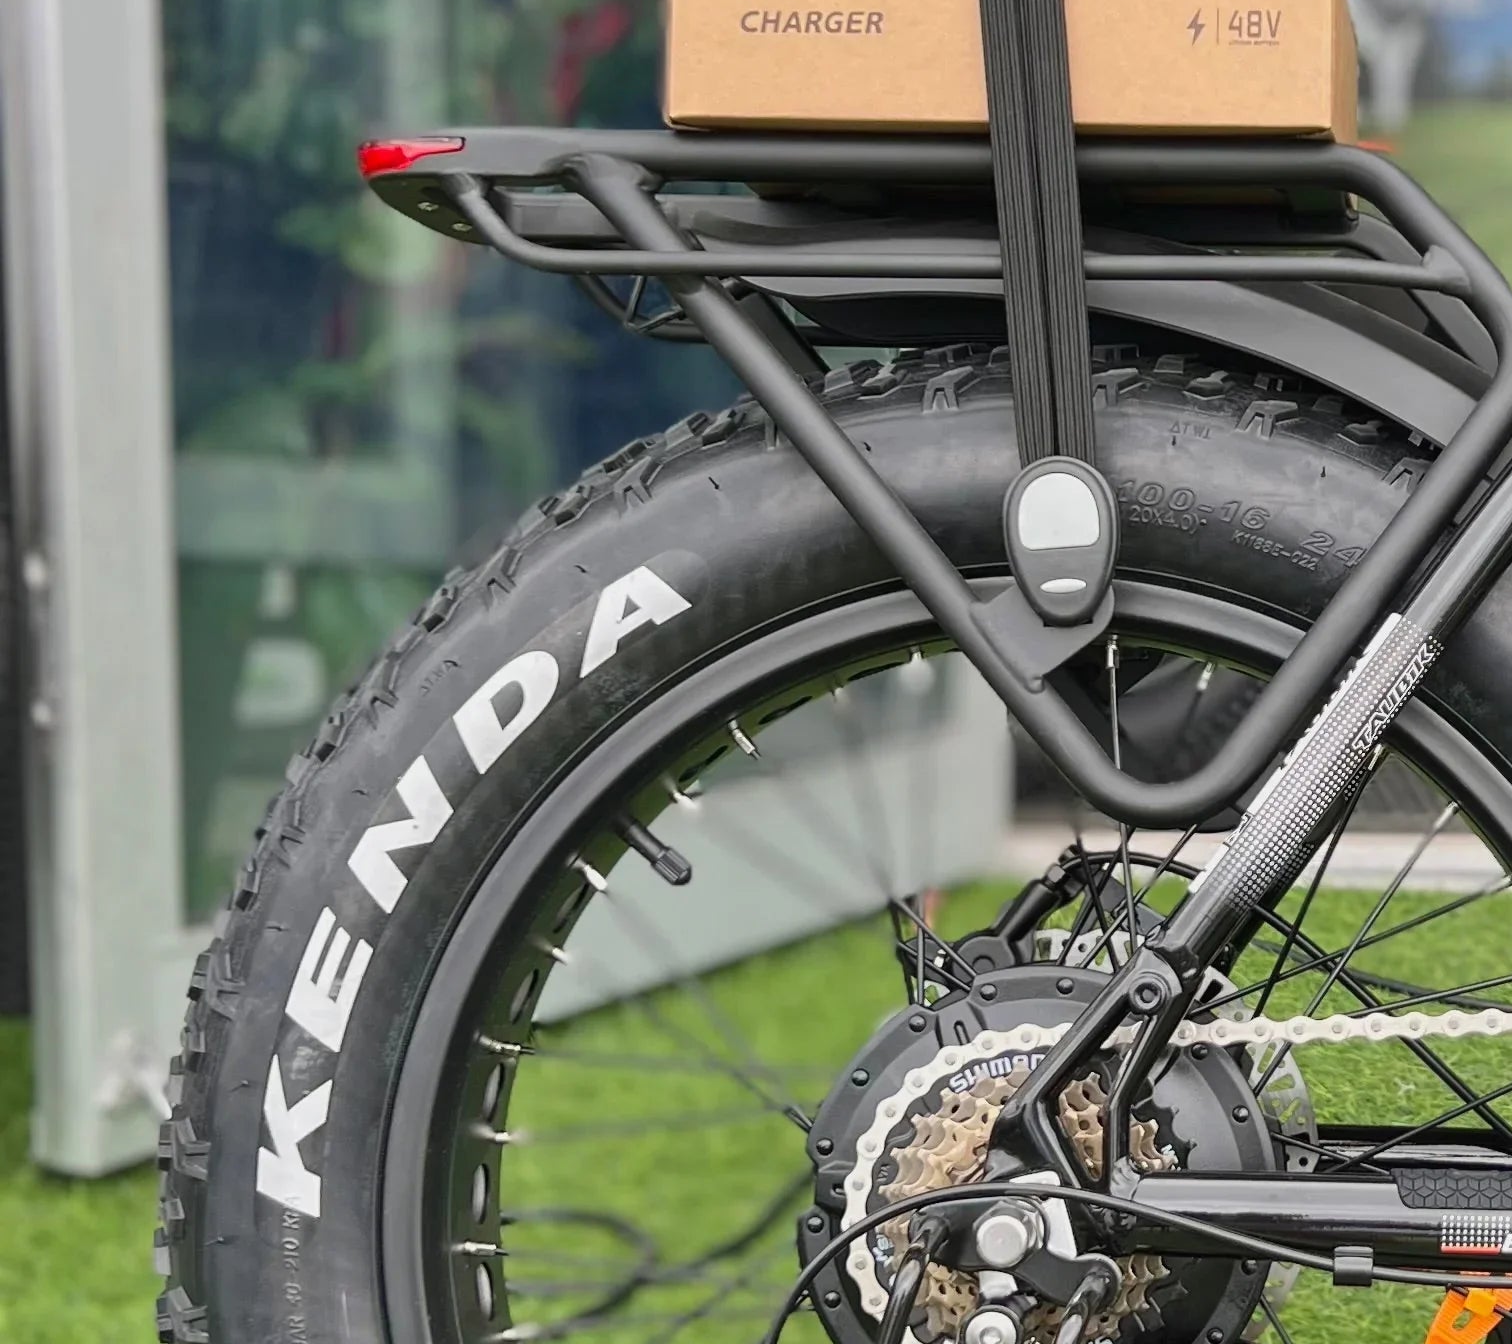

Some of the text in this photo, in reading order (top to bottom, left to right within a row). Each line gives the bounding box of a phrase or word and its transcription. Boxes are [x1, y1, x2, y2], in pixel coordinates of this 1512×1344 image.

[740, 9, 1282, 39] CHARGER 48V
[255, 565, 693, 1219] KENDA
